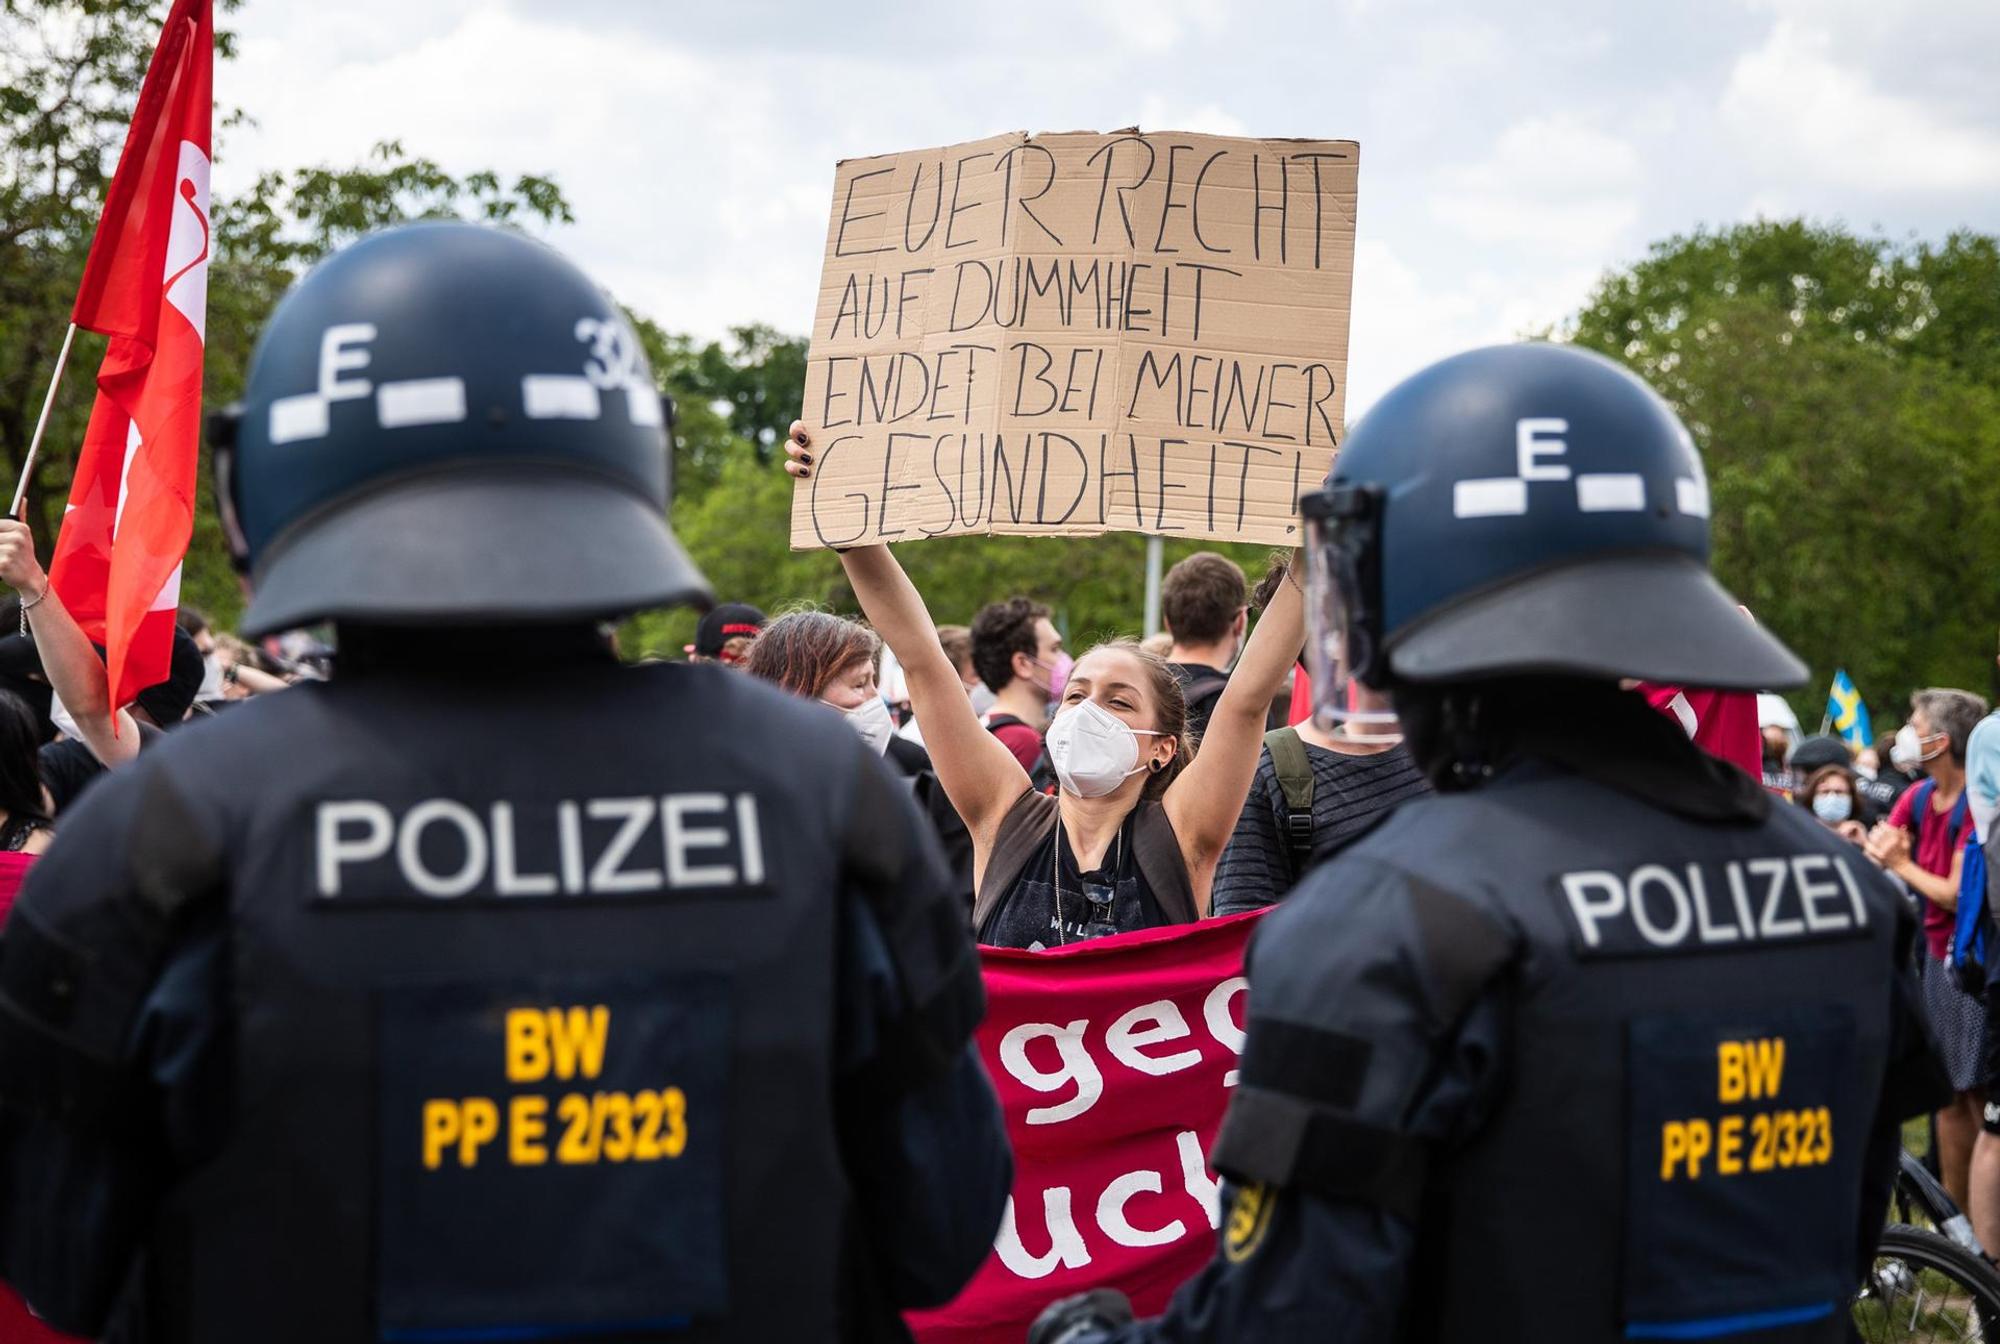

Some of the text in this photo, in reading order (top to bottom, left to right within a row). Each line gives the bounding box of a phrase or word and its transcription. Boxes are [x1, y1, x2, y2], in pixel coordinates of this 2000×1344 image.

[836, 137, 1348, 269] EUER RECHT
[830, 256, 1243, 341] AUF DUMMHEIT
[319, 322, 378, 401] E
[822, 342, 1337, 447] ENDET BEI MEINER
[812, 432, 1302, 546] GESUNDHEIT!
[1516, 417, 1572, 482] E
[316, 792, 765, 898] POLIZEI
[1561, 855, 1869, 948] POLIZEI
[504, 1005, 610, 1082] BW
[1717, 1036, 1786, 1103] BW
[422, 1086, 687, 1170] PP E 2/323
[1661, 1106, 1833, 1181] PP E 2/323
